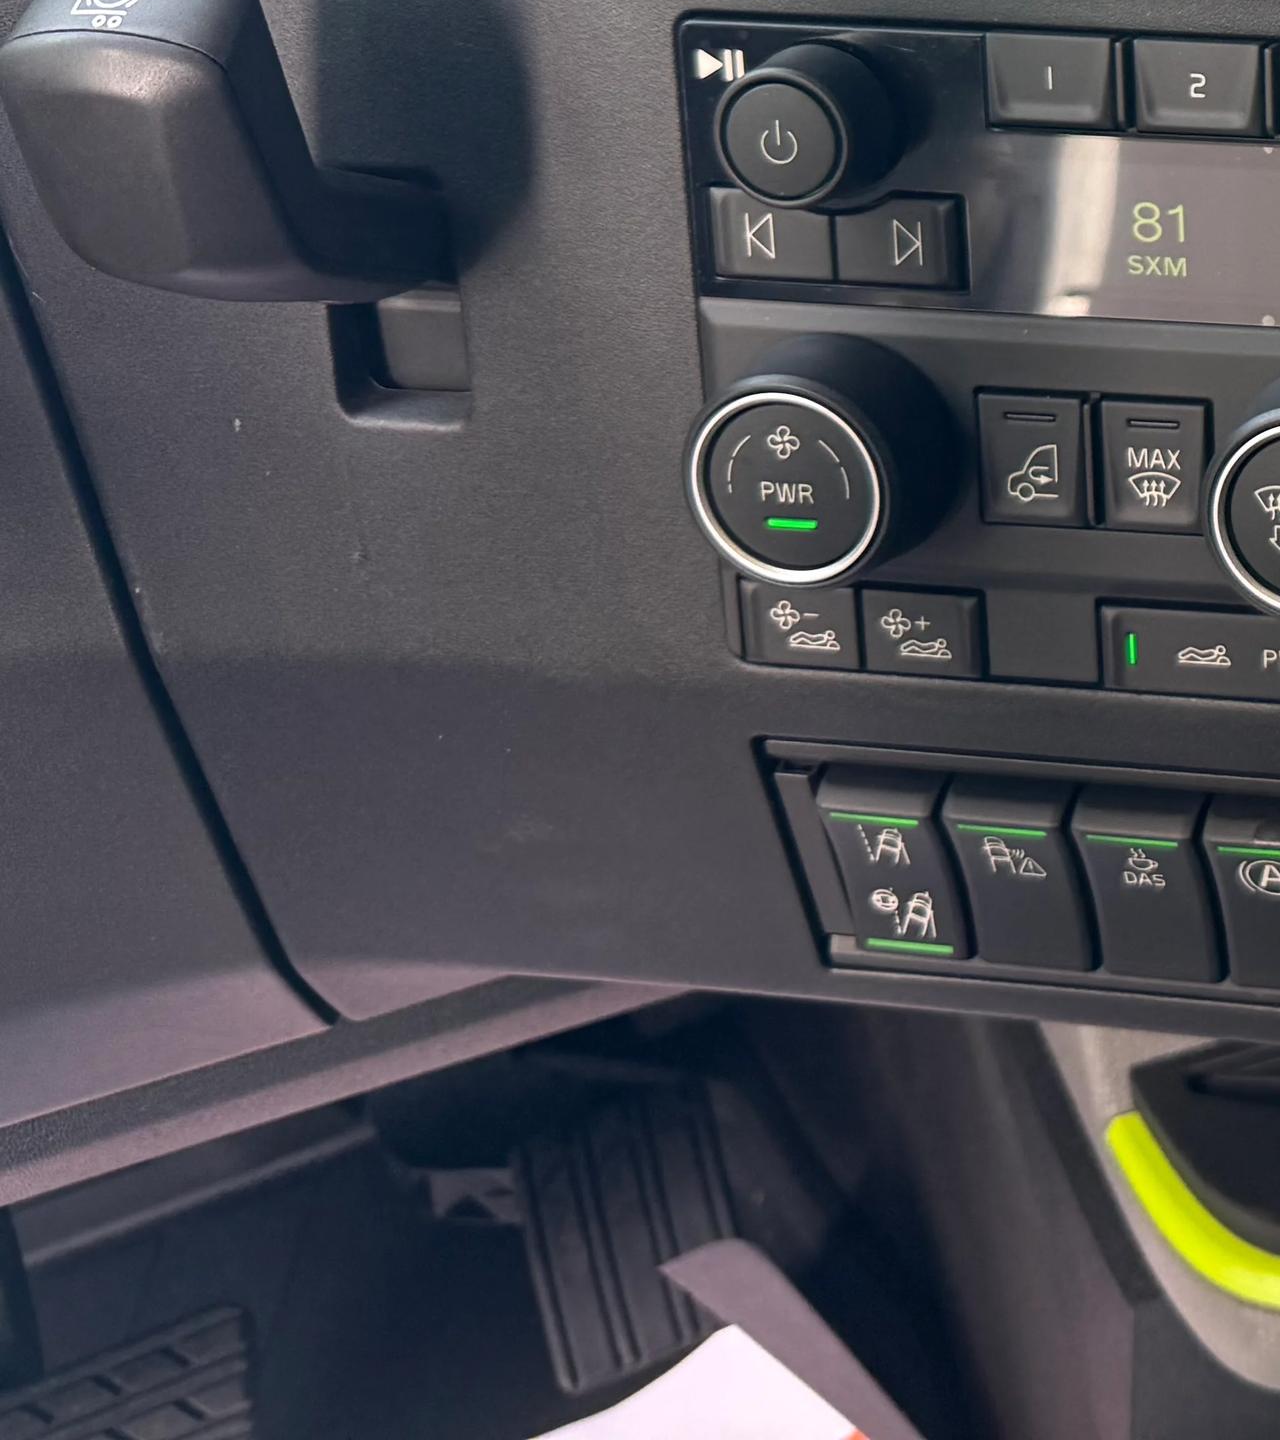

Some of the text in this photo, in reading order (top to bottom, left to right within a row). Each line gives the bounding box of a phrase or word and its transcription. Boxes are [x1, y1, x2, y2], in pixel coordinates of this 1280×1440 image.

[1189, 73, 1206, 98] 2
[1132, 201, 1185, 243] 81
[1127, 254, 1187, 277] SXM
[1127, 447, 1181, 470] MAX
[760, 480, 814, 504] PWR
[1123, 870, 1167, 888] DAS
